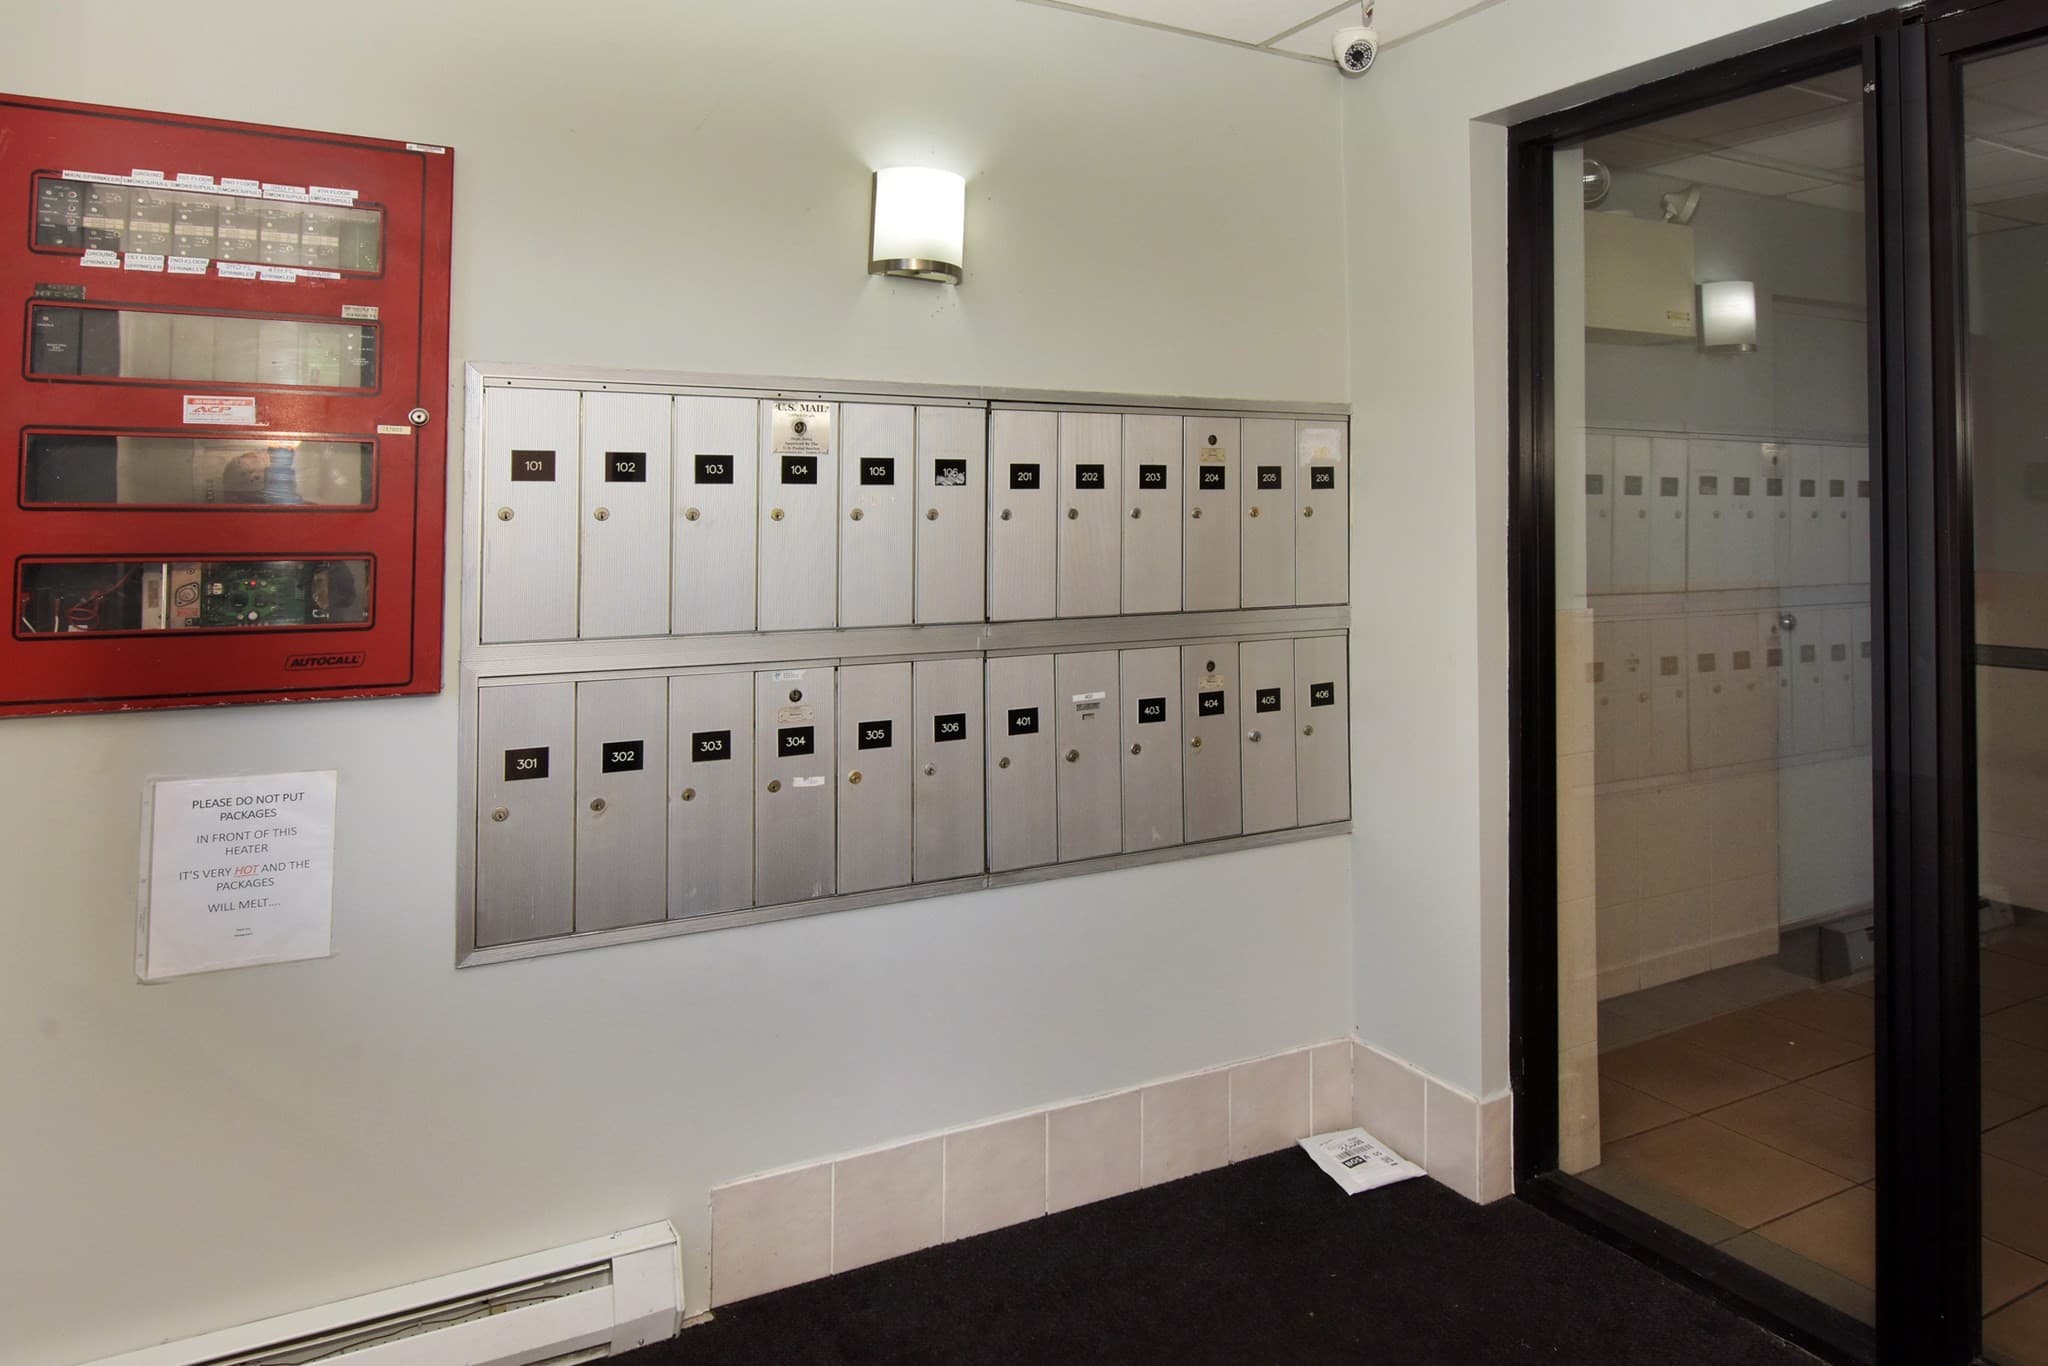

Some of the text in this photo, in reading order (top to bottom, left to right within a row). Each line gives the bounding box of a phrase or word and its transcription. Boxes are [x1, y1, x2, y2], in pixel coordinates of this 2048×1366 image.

[777, 402, 797, 412] U.S.
[525, 460, 543, 471] 101
[616, 462, 635, 473] 102
[705, 464, 723, 475] 103
[790, 465, 808, 475] 104
[869, 466, 886, 476] 105
[943, 467, 959, 478] 106
[1017, 472, 1032, 481] 201
[1081, 472, 1098, 481] 202
[1145, 472, 1160, 482] 203
[1204, 474, 1219, 482] 204
[1262, 473, 1277, 482] 205
[1315, 474, 1329, 482] 206
[290, 655, 359, 668] AUTOCALL
[1261, 695, 1275, 705] 405
[1315, 690, 1329, 699] 406
[1204, 699, 1218, 708] 404
[1144, 705, 1160, 715] 403
[1016, 716, 1031, 726] 401
[941, 722, 960, 733] 306
[865, 730, 885, 740] 305
[700, 740, 722, 752] 303
[785, 736, 806, 747] 304
[611, 751, 634, 762] 302
[516, 758, 537, 770] 301
[192, 792, 304, 809] PLEASE DO NOT PUT
[220, 808, 277, 822] PACKAGES
[196, 827, 298, 844] IN FRONT OF THIS
[225, 843, 268, 856] HEATER
[179, 859, 310, 881] IT'S VERY HOT AND THE
[216, 877, 275, 891] PACKAGES
[207, 902, 236, 913] WILL
